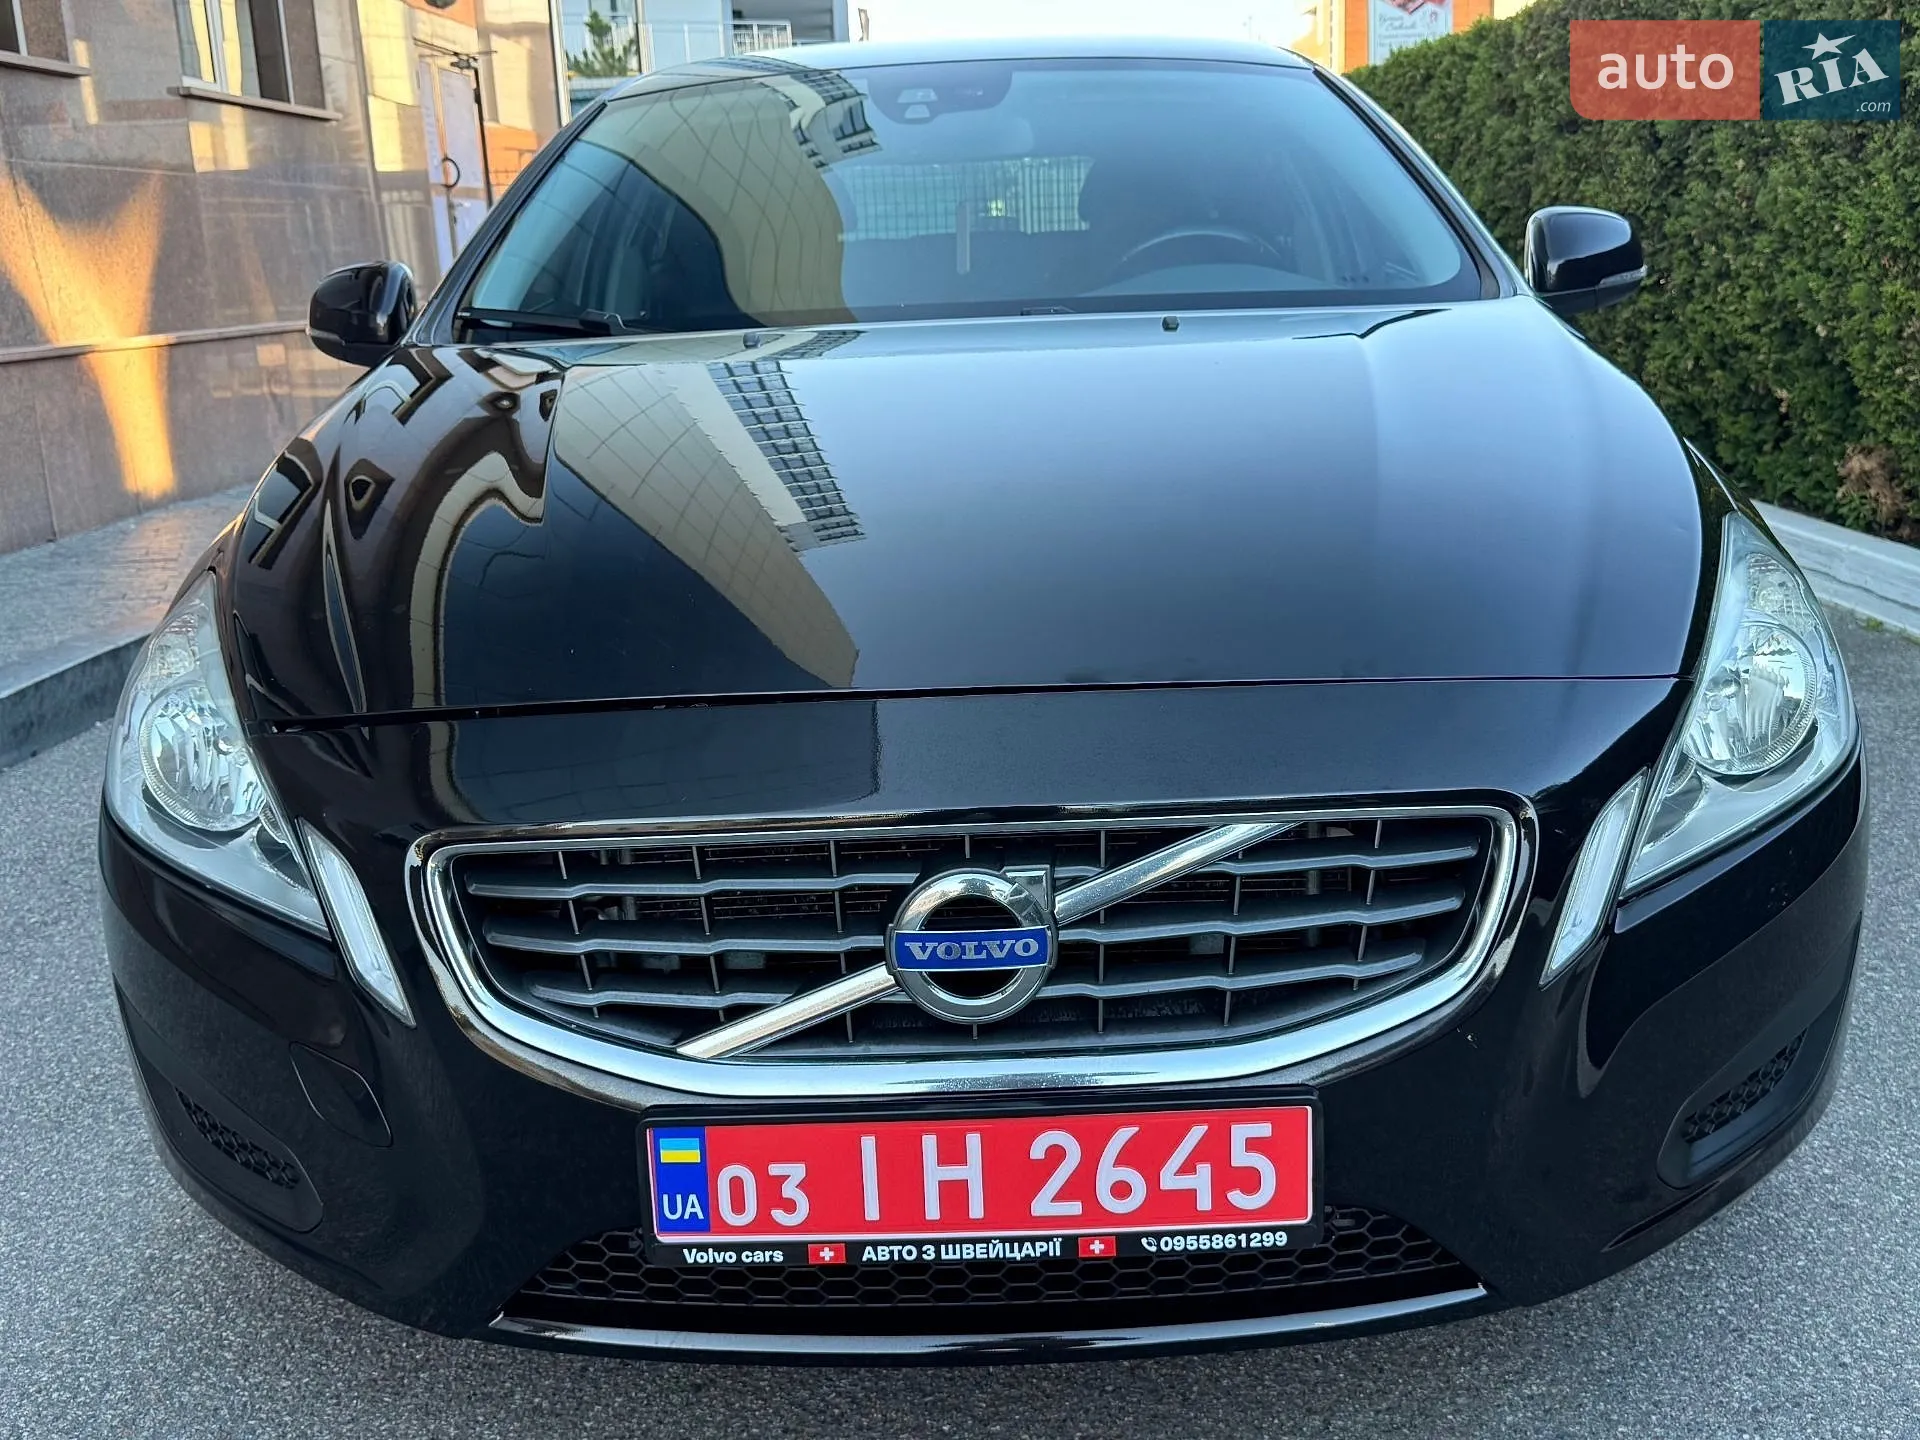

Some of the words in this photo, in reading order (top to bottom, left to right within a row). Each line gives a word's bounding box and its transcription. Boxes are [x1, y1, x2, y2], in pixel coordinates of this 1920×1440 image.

[904, 938, 1039, 961] VOLVO
[716, 1162, 810, 1227] 03
[1029, 1122, 1277, 1217] 2645
[662, 1193, 704, 1220] UA
[861, 1245, 917, 1262] АВТО
[940, 1237, 1062, 1261] ШВЕЙЦАРІЇ
[1159, 1230, 1288, 1251] 0955861299
[682, 1248, 739, 1264] Volvo
[741, 1249, 784, 1264] cars
